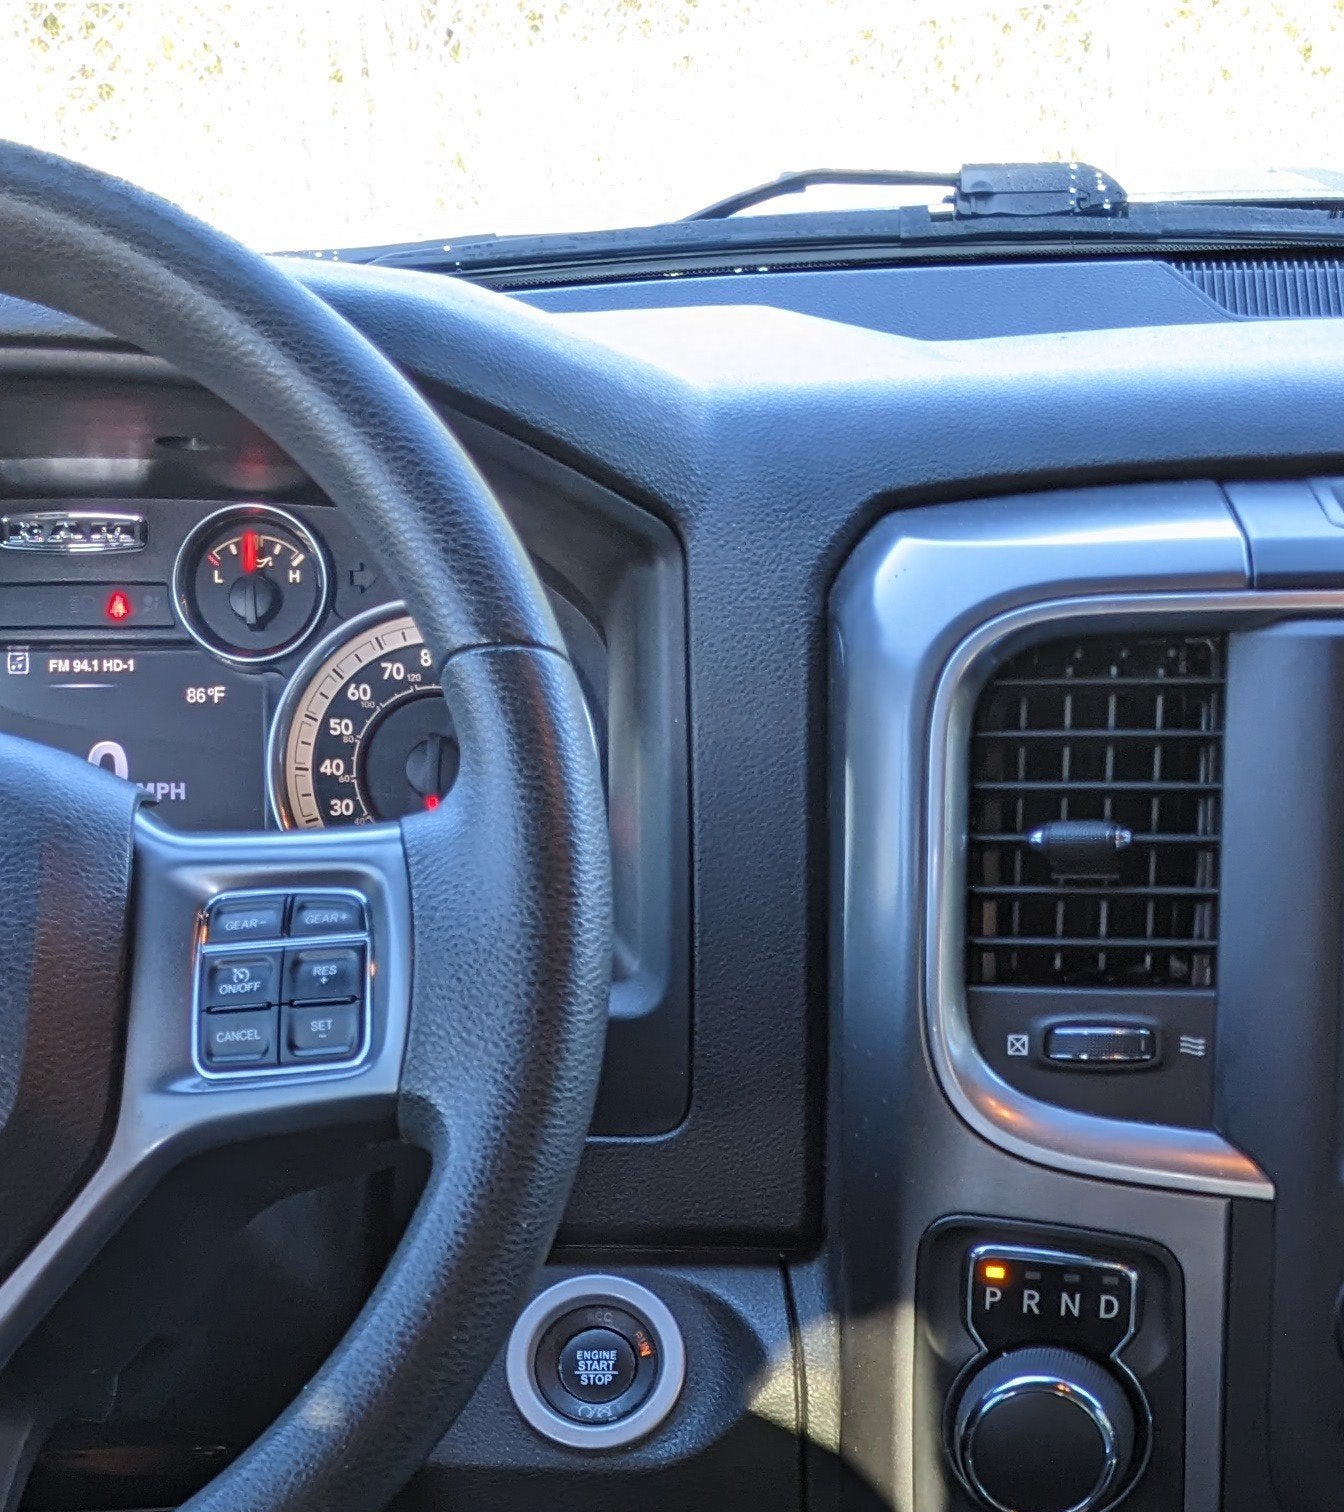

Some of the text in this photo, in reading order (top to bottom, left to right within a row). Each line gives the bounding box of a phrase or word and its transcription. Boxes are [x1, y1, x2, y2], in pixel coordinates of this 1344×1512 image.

[213, 569, 224, 584] L
[288, 569, 301, 584] H
[420, 649, 433, 667] 8
[49, 659, 135, 672] FM 94.1 HD-1
[381, 663, 404, 680] 70
[347, 684, 371, 701] 60
[329, 719, 353, 735] 50
[320, 759, 344, 776] 40
[330, 800, 354, 816] 30
[225, 919, 258, 931] GEAR
[305, 912, 338, 924] GEAR
[312, 965, 337, 976] RES
[310, 1018, 334, 1032] SET
[216, 1029, 262, 1043] CANCEL
[984, 1287, 1120, 1320] P R N D
[576, 1350, 617, 1361] ENGINE
[578, 1360, 616, 1371] START
[580, 1374, 614, 1386] STOP
